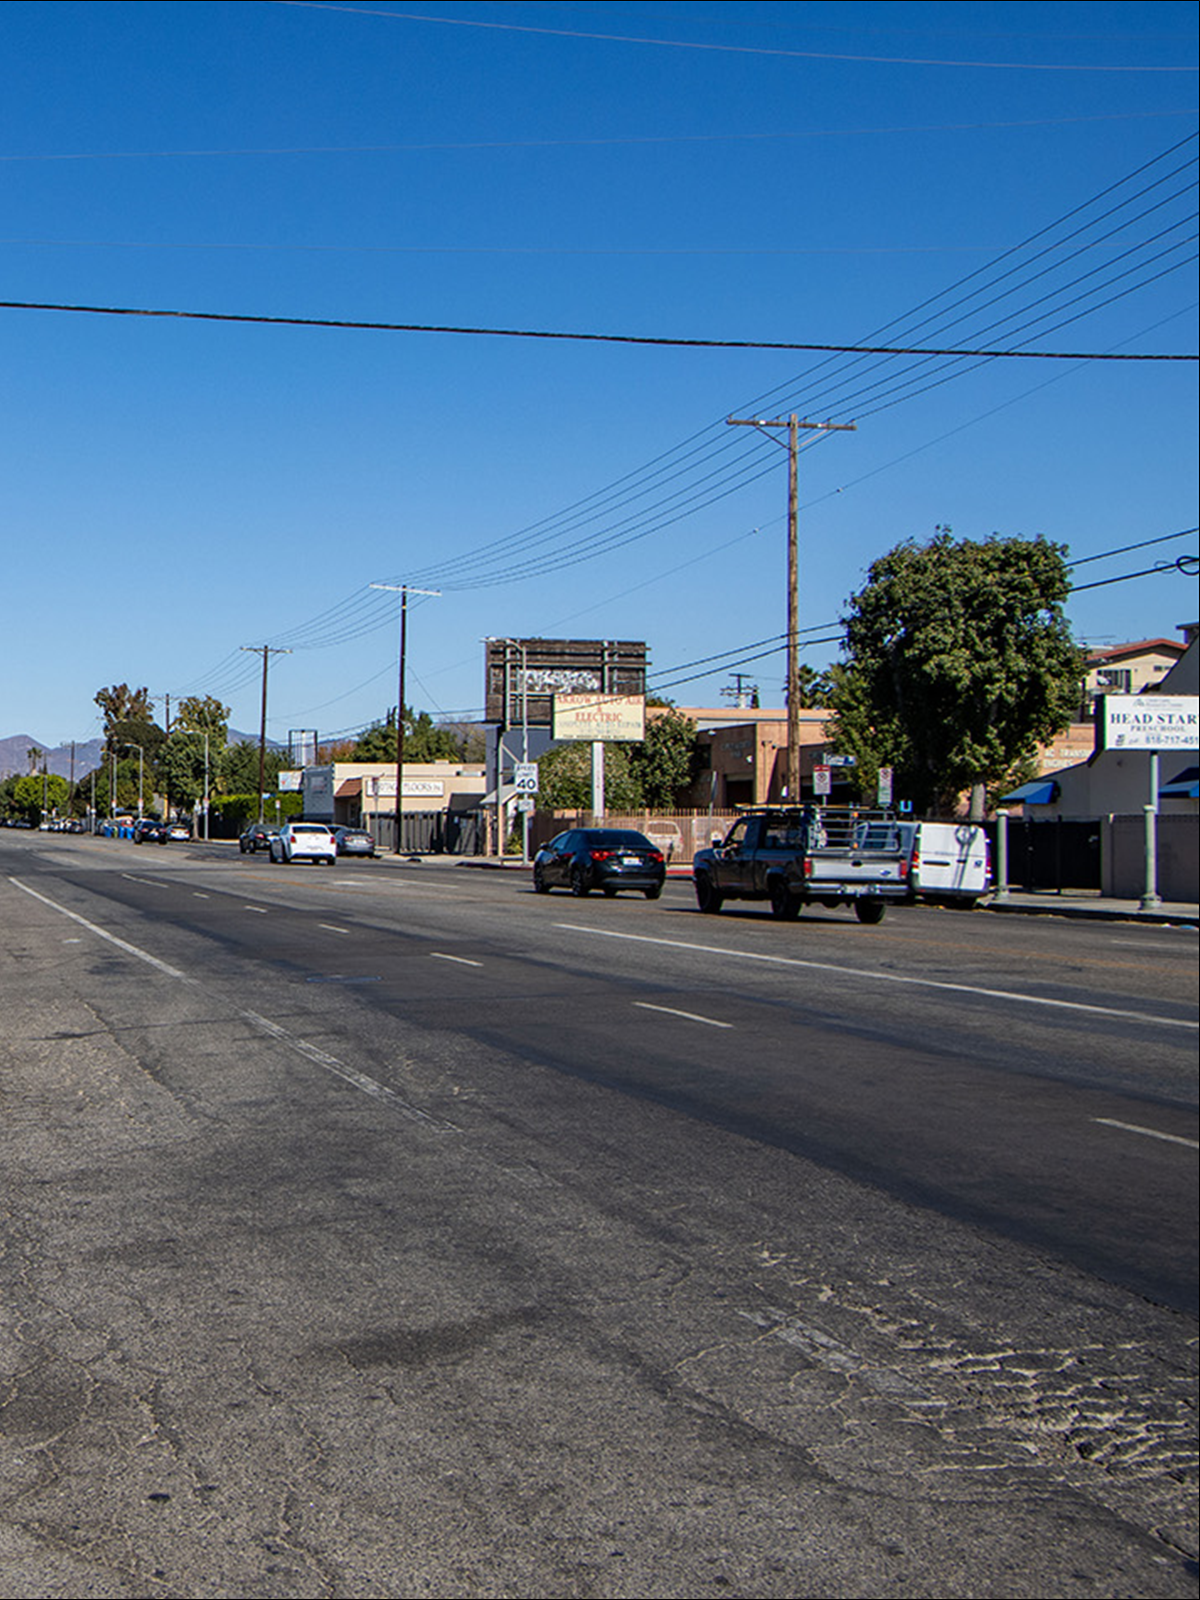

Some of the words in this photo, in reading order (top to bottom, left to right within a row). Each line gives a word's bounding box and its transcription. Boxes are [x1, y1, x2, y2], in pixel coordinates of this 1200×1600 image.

[575, 712, 623, 722] ELECTRIC
[1111, 713, 1153, 724] HEAD
[1157, 713, 1199, 724] STAR
[516, 778, 536, 790] 40
